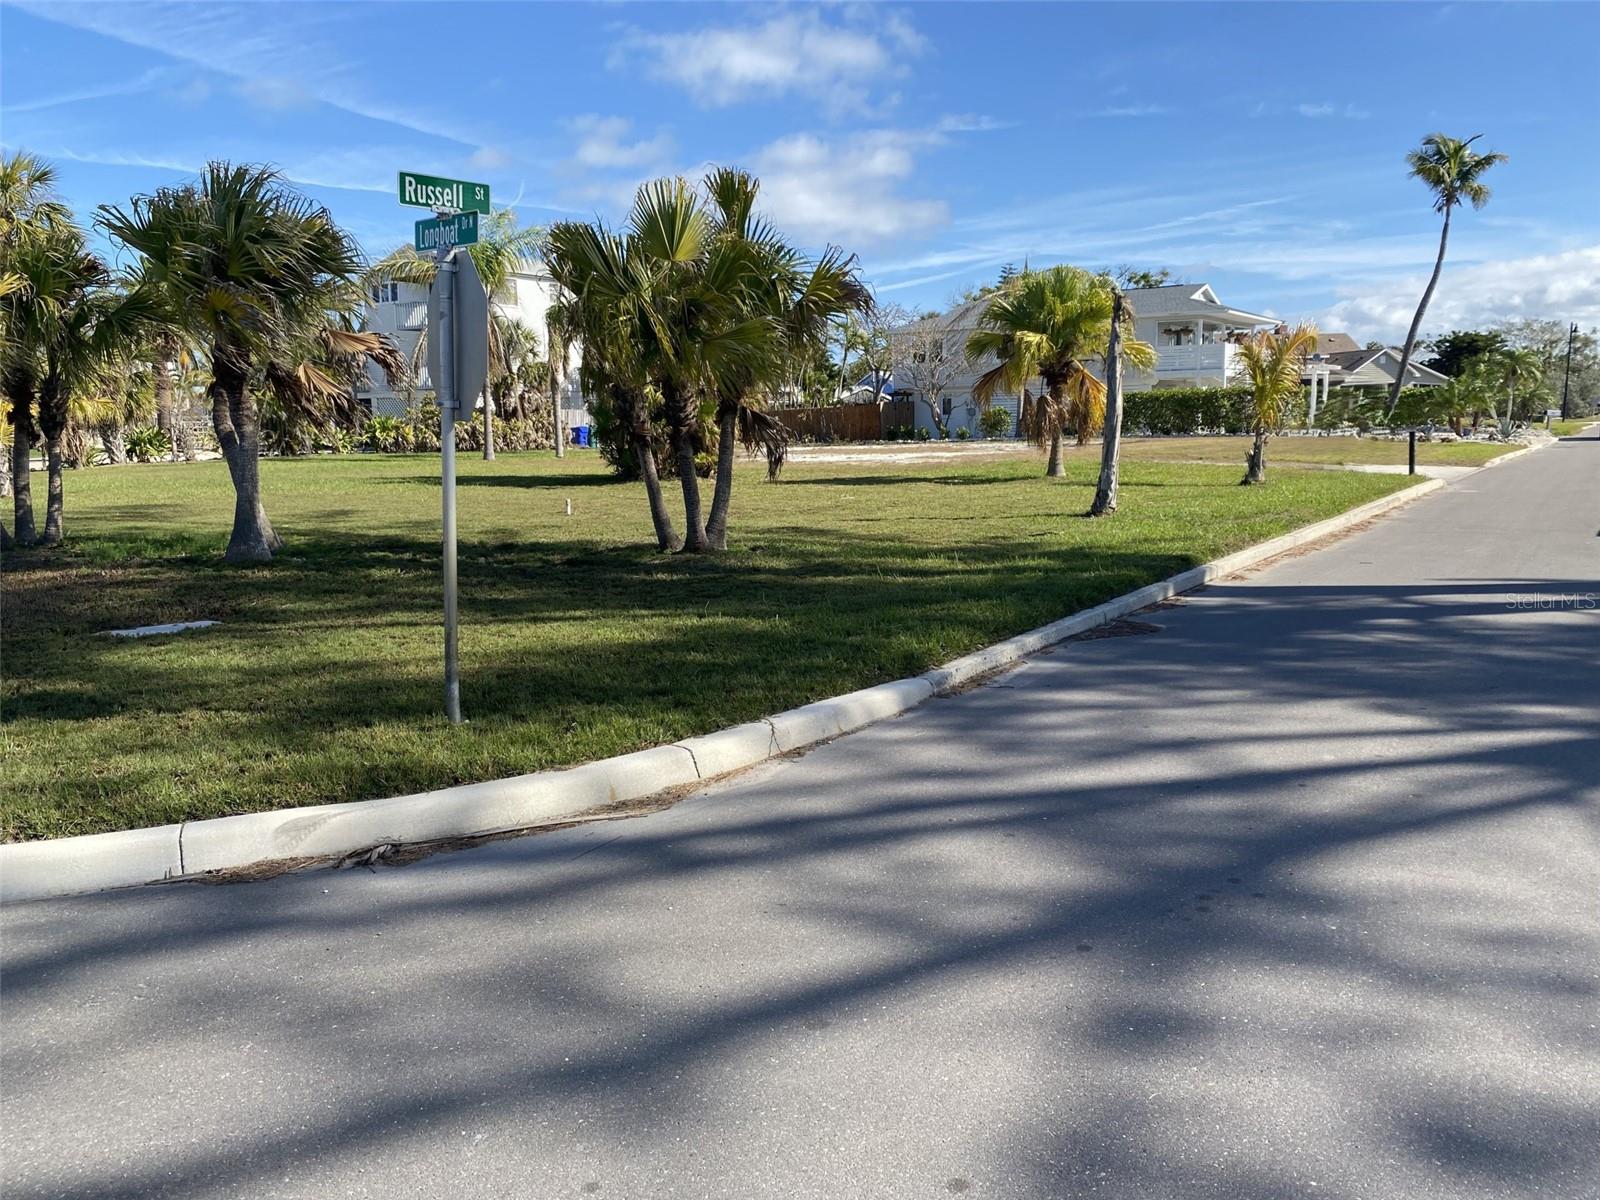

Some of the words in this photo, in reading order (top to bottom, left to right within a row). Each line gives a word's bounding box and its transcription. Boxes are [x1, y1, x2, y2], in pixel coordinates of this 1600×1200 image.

[405, 176, 463, 208] Russell
[475, 186, 484, 201] St
[420, 218, 459, 249] Longboat
[461, 217, 468, 230] Dr
[469, 215, 473, 228] N
